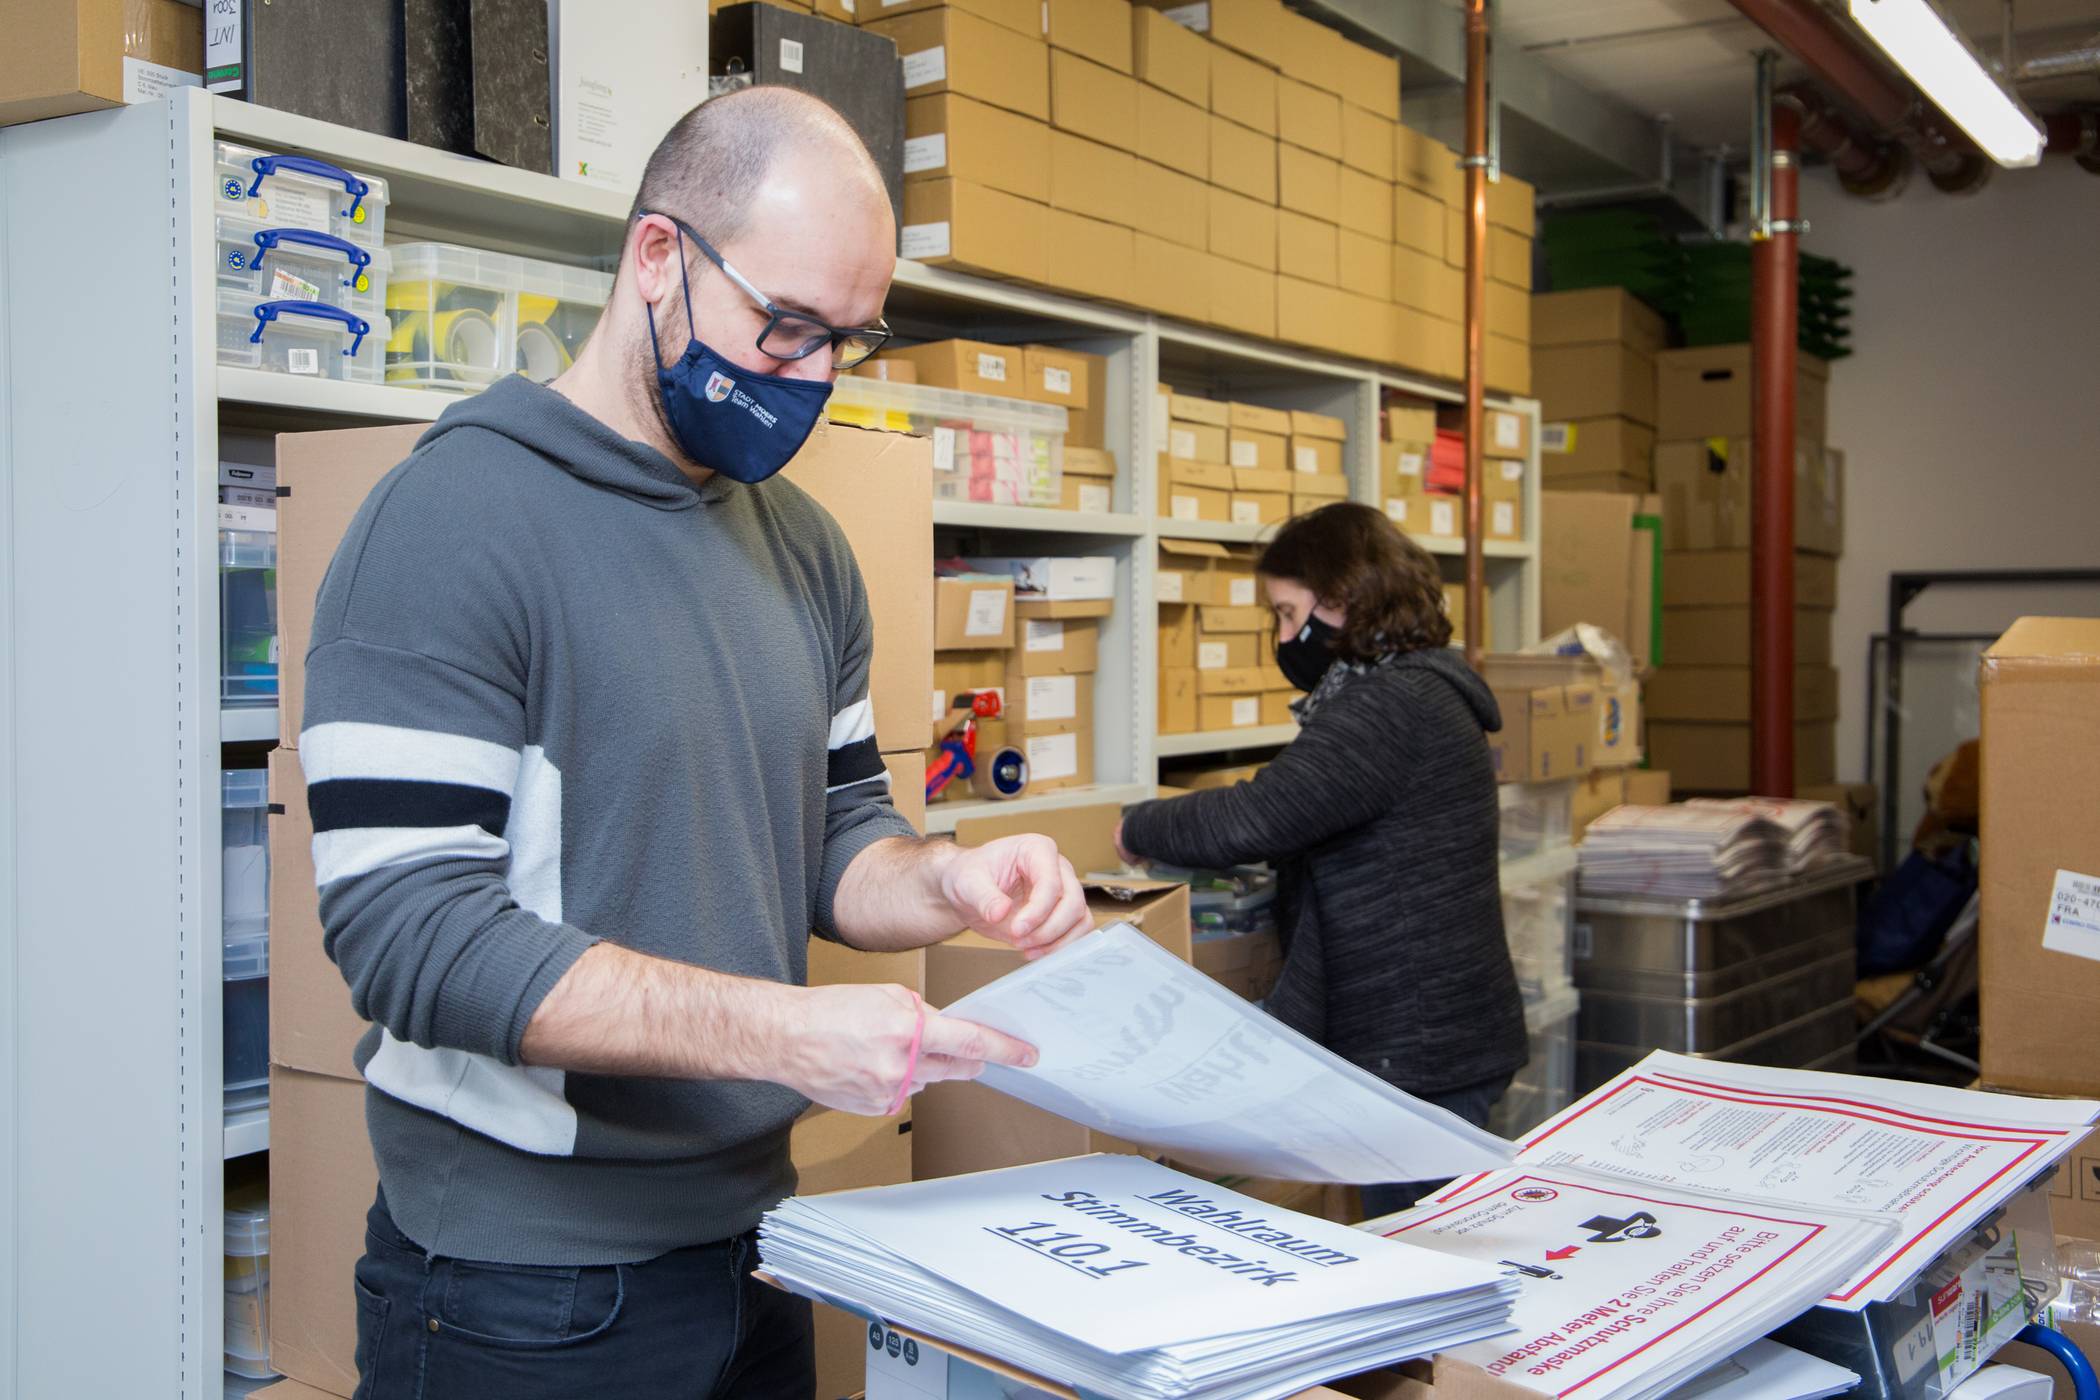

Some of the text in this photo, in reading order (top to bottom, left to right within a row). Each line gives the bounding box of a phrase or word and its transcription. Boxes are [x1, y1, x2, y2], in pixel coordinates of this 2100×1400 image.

[209, 24, 235, 46] INT
[731, 395, 774, 429] Team Wahlen
[734, 389, 778, 423] STADT MOERS
[2058, 903, 2079, 916] FRA
[1926, 1155, 1976, 1187] Ansteckung
[1148, 1189, 1359, 1265] Wahlraum
[1471, 1214, 1504, 1228] Schutz
[1040, 1191, 1299, 1287] Stimmbezirk
[1722, 1225, 1745, 1243] auf
[996, 1221, 1150, 1276] 110.1
[1690, 1241, 1721, 1260] und
[1648, 1258, 1693, 1287] halten
[1527, 1231, 1779, 1376] Bitte setzen Sie Ihre Schutzmaske
[1607, 1298, 1631, 1307] 2
[1621, 1285, 1656, 1300] Sie
[1561, 1305, 1618, 1334] Meter
[873, 1331, 880, 1341] A3
[888, 1336, 898, 1346] 125
